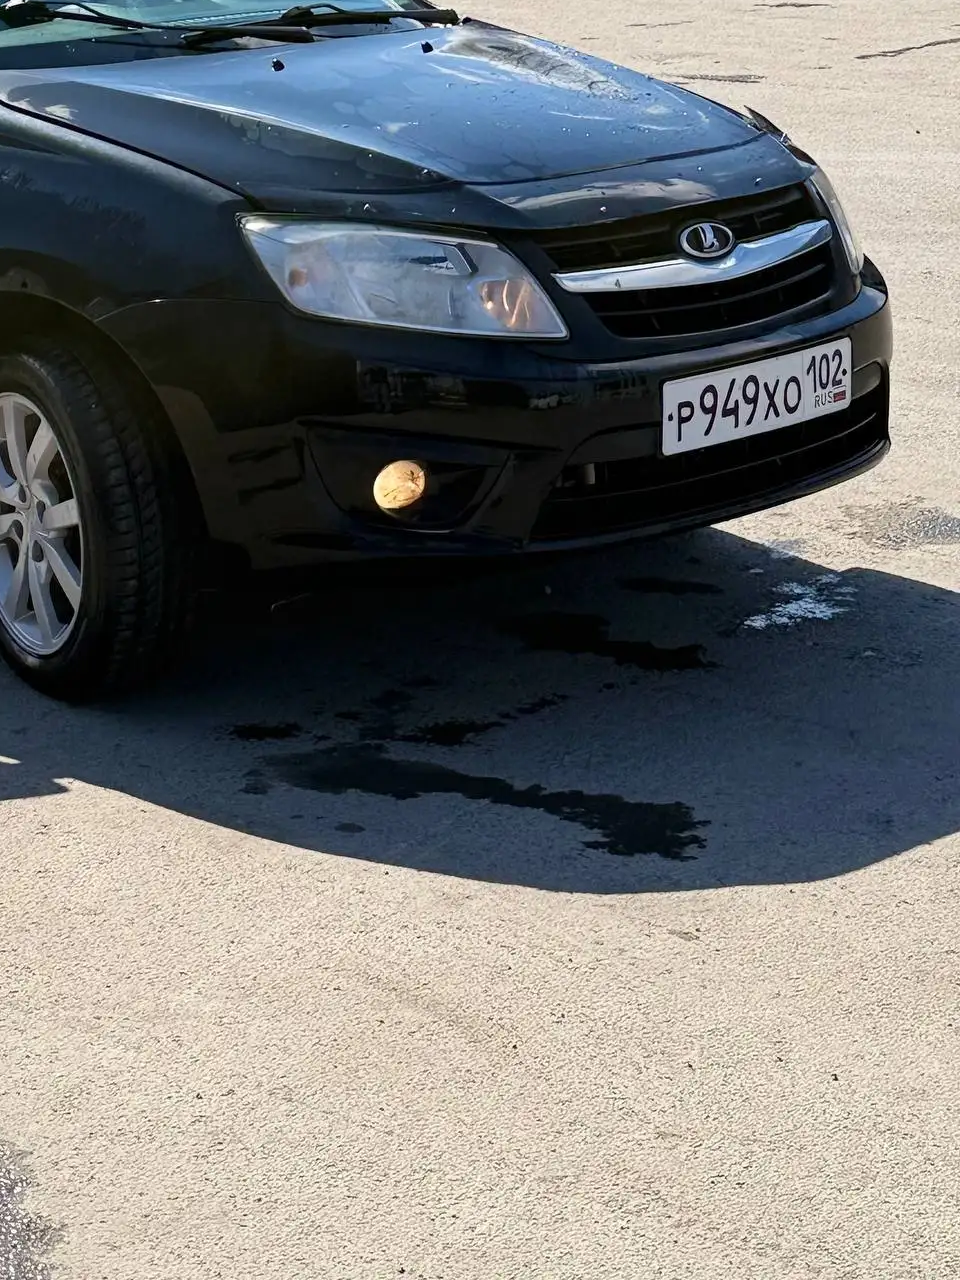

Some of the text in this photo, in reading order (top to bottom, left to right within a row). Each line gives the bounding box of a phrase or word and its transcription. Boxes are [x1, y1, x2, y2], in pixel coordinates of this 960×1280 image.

[806, 348, 843, 394] 102
[677, 374, 802, 442] Р949ХО
[813, 391, 833, 409] RUS
